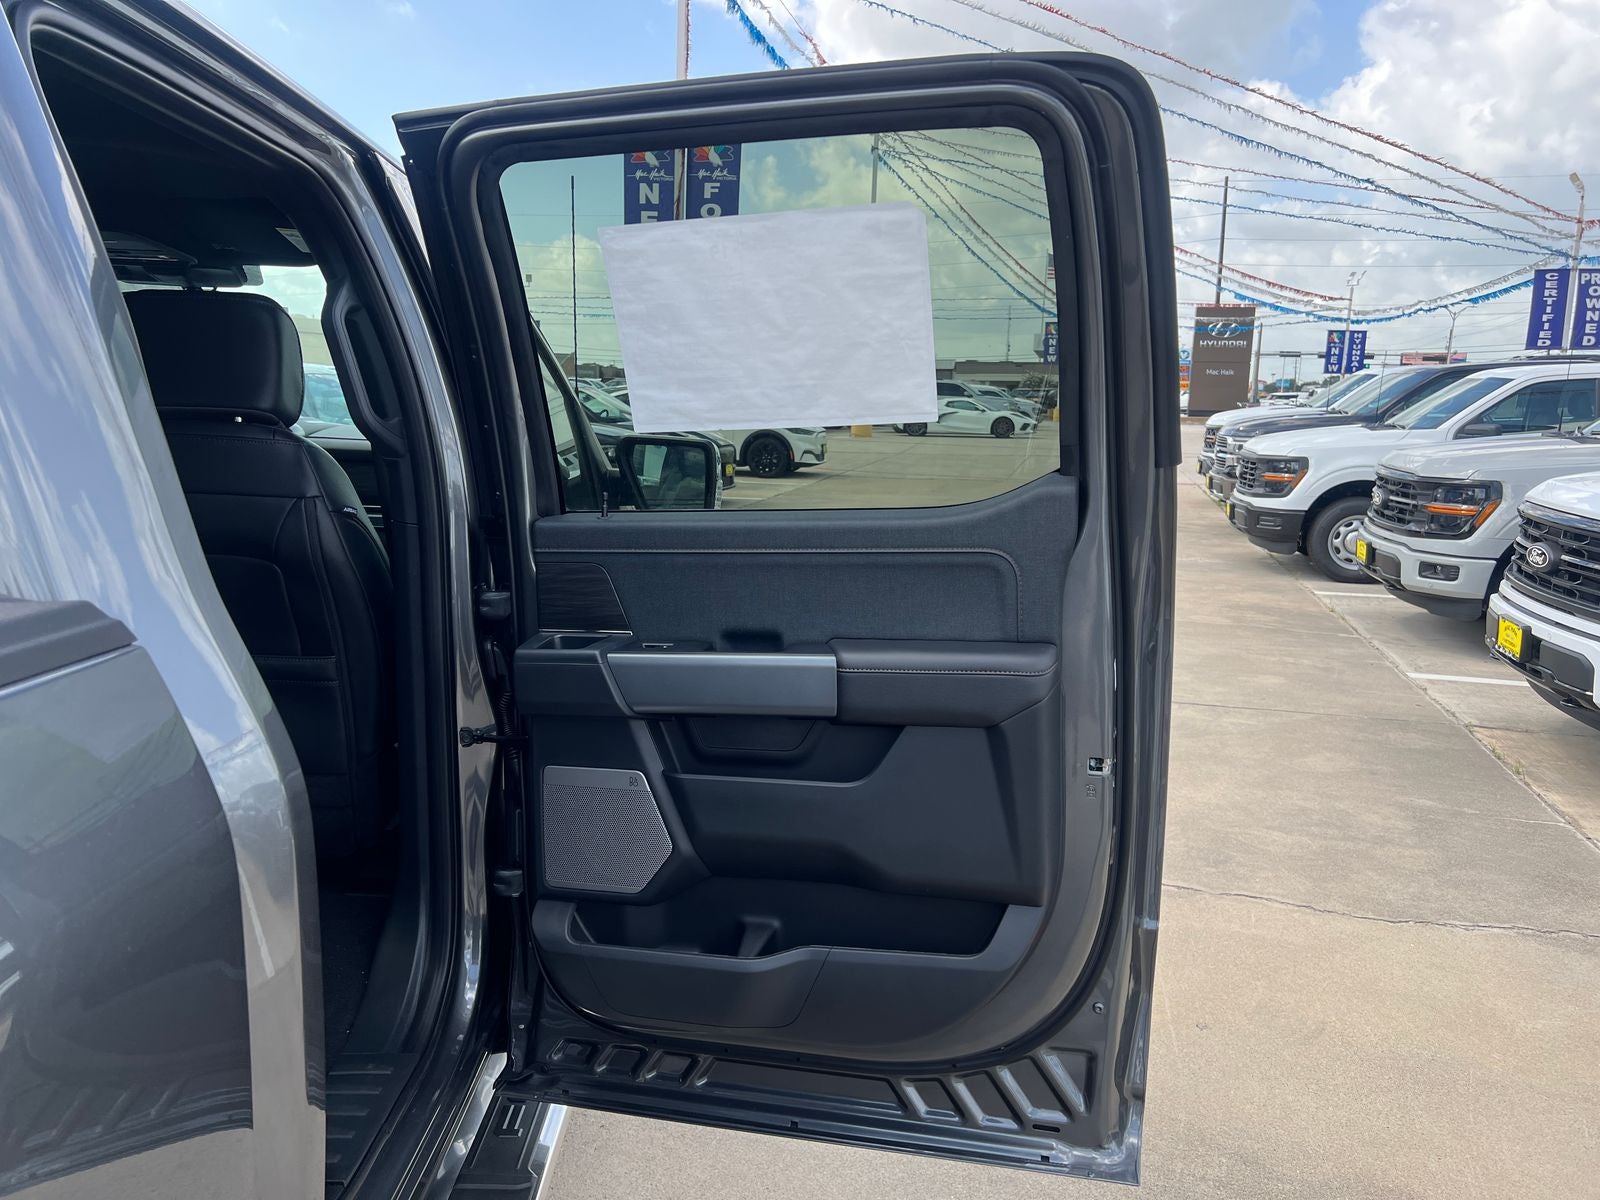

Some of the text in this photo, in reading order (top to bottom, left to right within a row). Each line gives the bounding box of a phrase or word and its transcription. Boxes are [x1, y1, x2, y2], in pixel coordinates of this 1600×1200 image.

[1537, 272, 1559, 347] CERTIFIED
[1047, 338, 1057, 362] NEW
[1200, 340, 1247, 348] HYUNDAI
[1351, 333, 1363, 373] HYUNDAI
[1328, 347, 1339, 372] NEW
